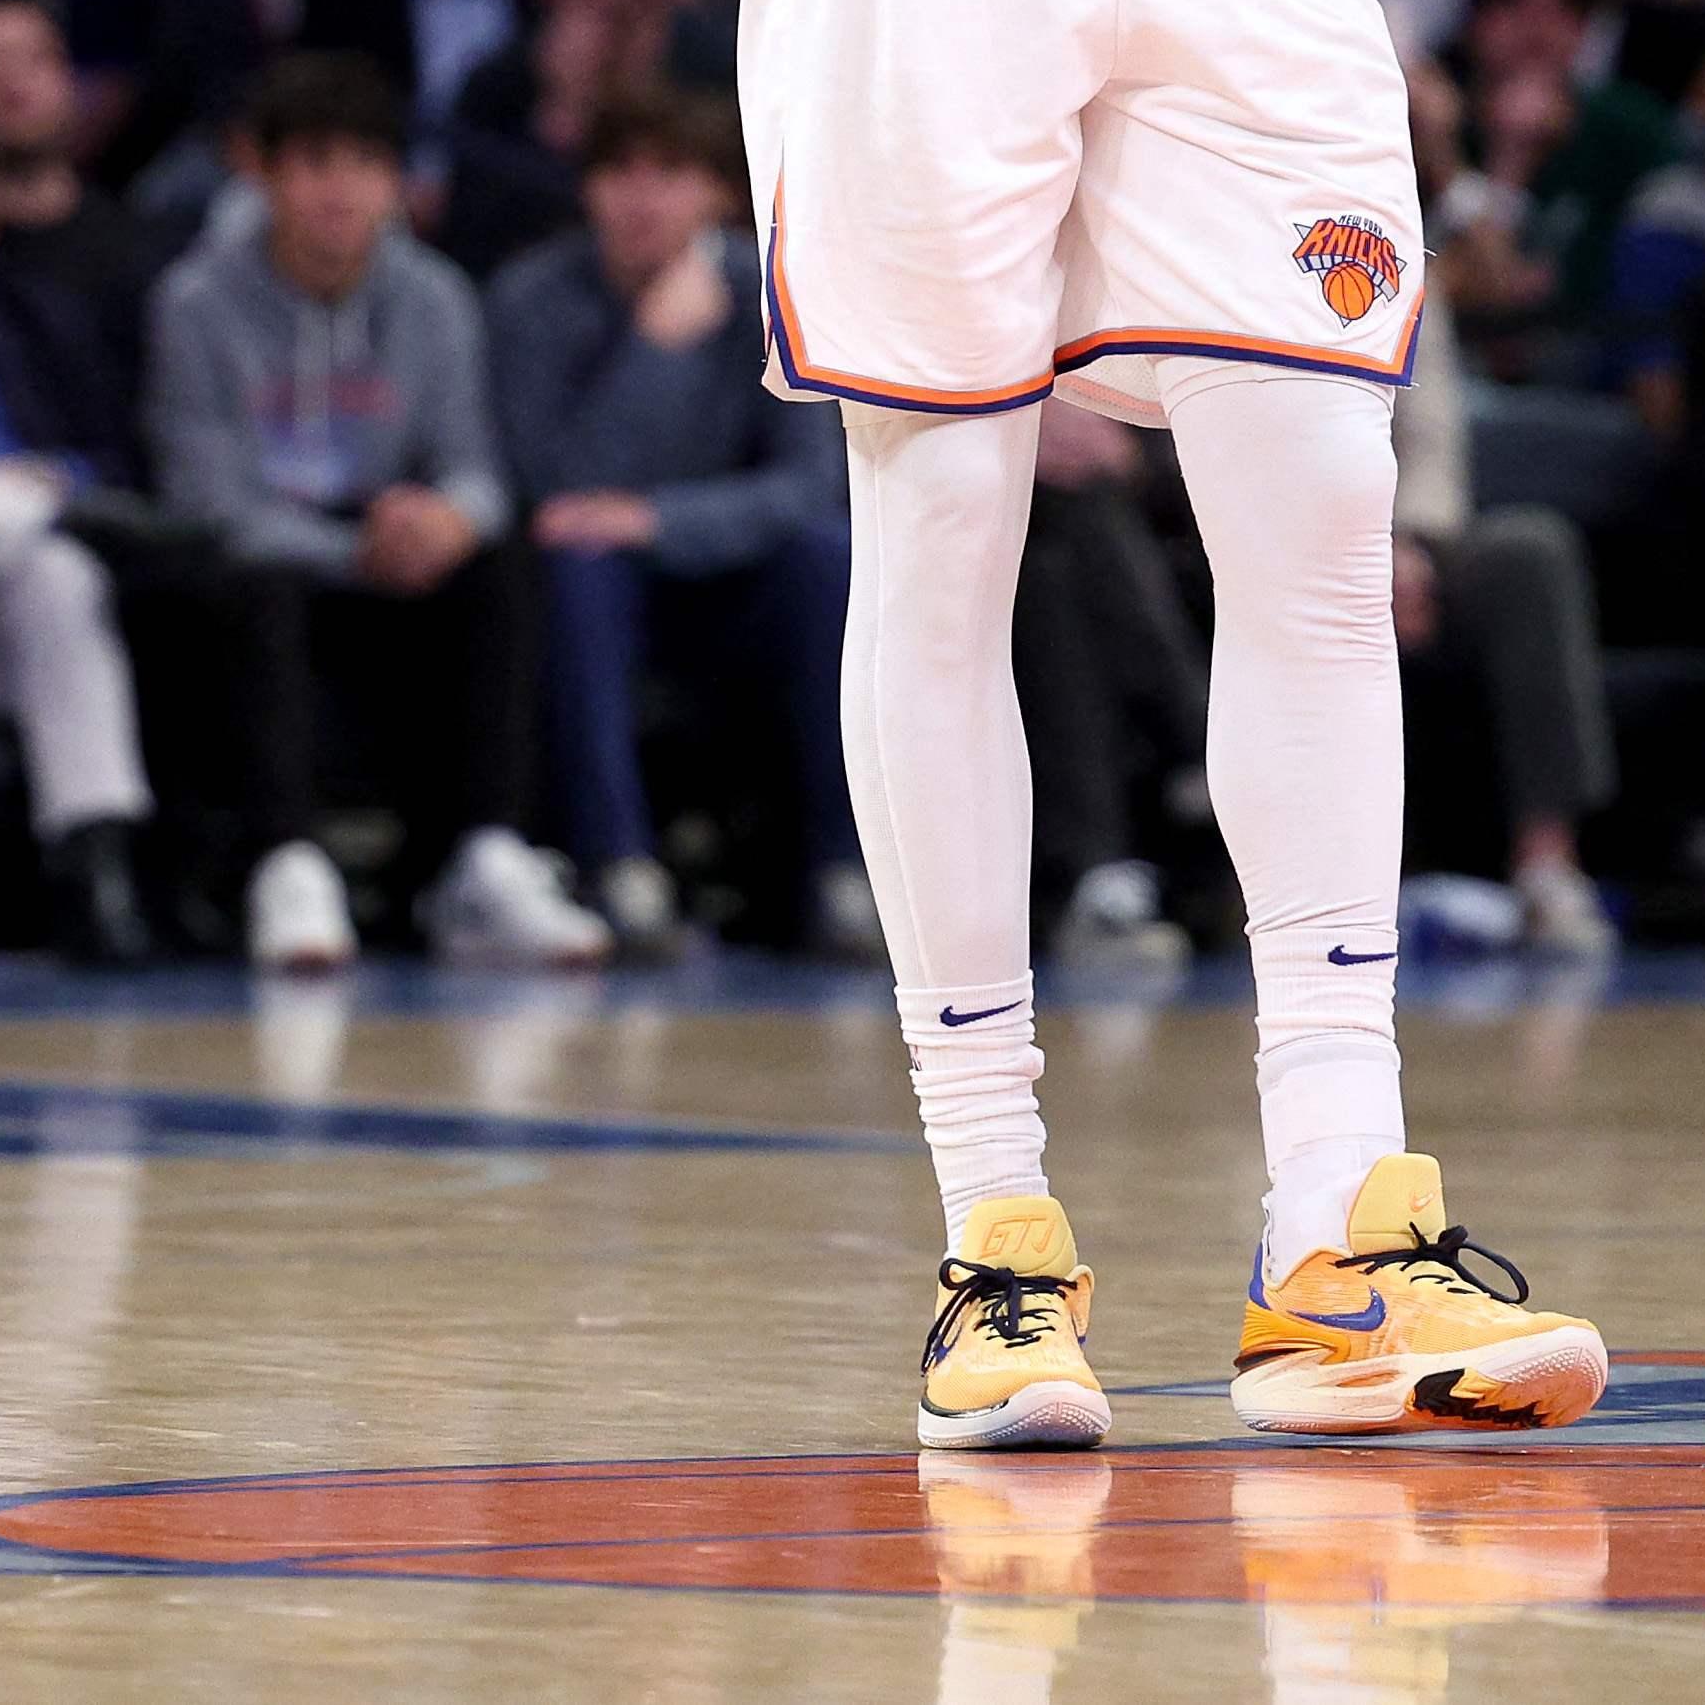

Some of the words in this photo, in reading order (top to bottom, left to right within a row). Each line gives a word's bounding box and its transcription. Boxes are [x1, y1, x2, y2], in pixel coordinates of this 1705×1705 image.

[1338, 214, 1362, 226] NEW
[1363, 217, 1383, 239] YORK
[1293, 217, 1399, 295] KNICKS
